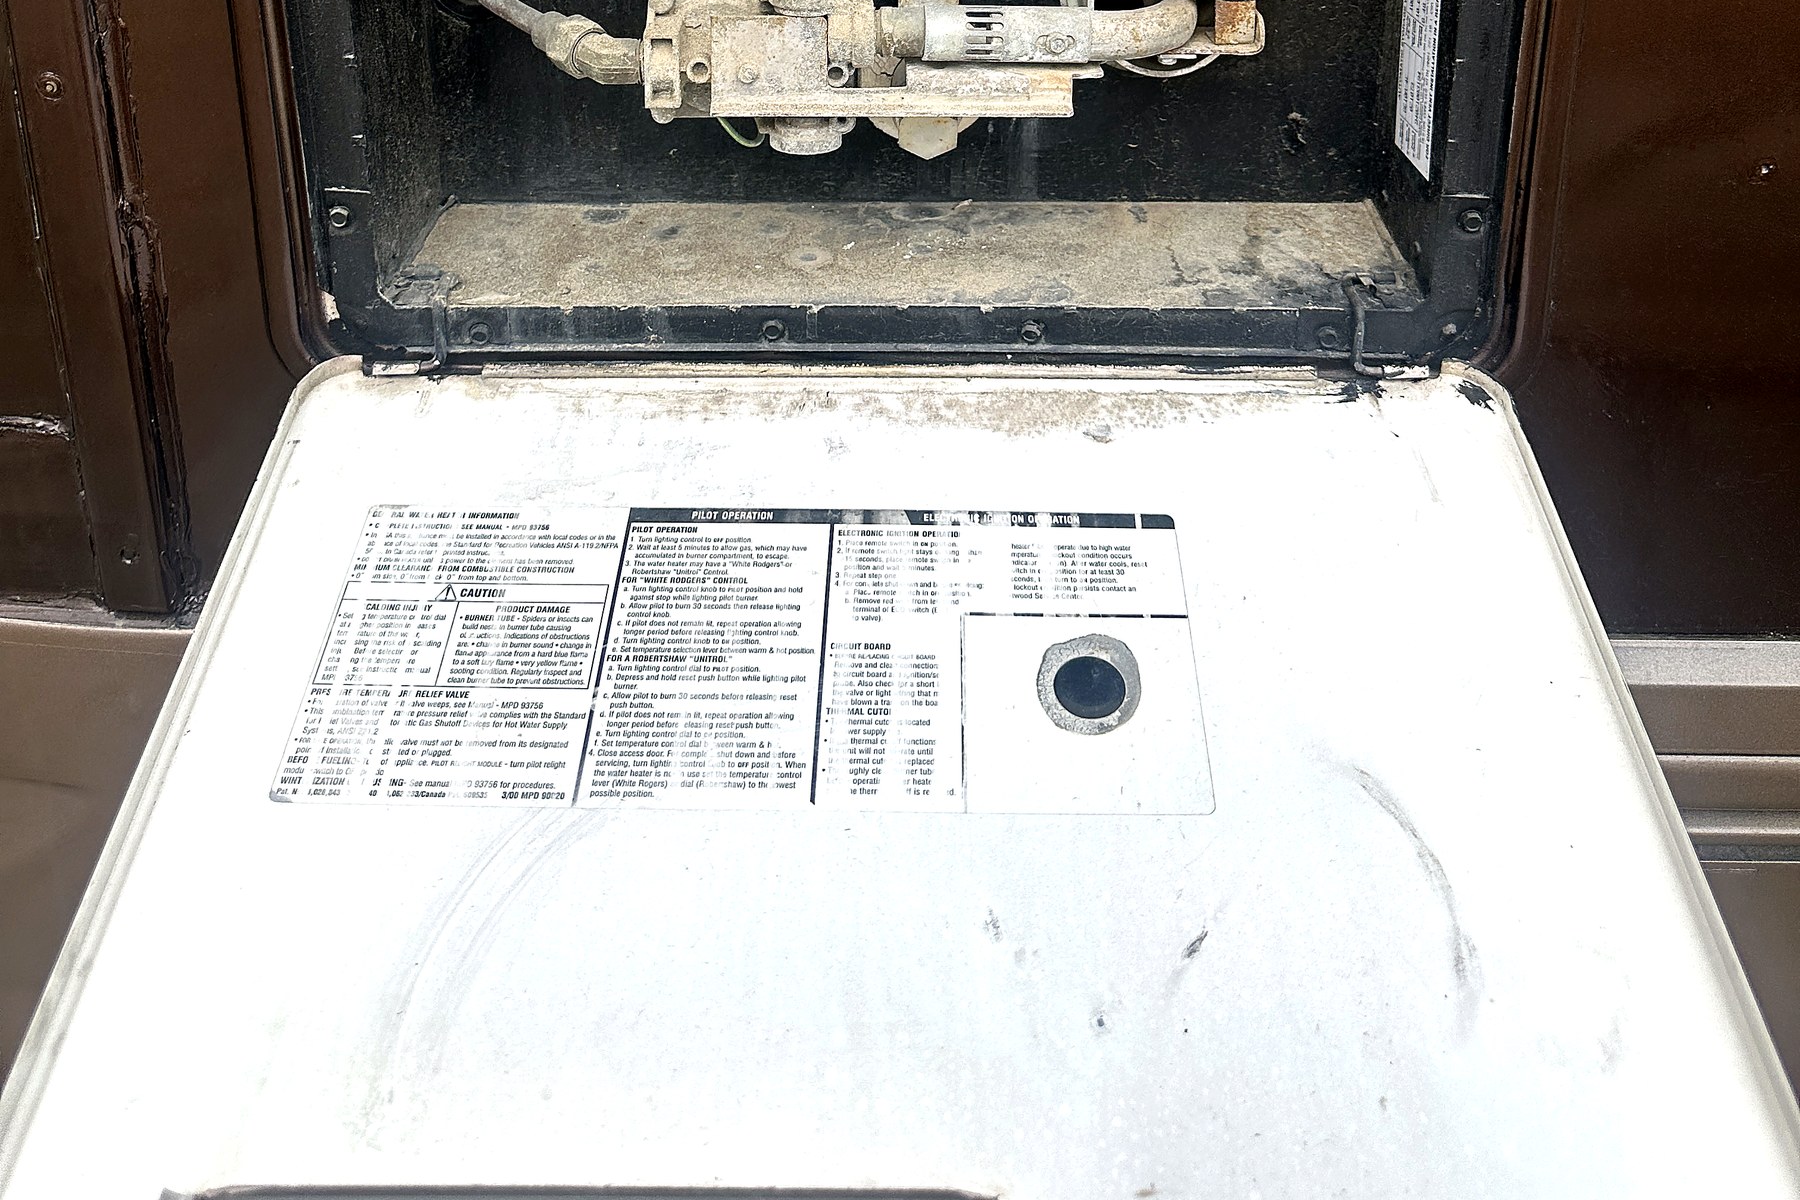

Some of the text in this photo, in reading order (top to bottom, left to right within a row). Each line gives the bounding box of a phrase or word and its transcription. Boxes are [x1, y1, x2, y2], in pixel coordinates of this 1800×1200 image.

[1434, 23, 1437, 31] A
[1433, 31, 1437, 41] IN
[692, 512, 774, 521] PILOT OPERATION
[460, 588, 506, 597] CAUTION
[692, 594, 717, 602] lighting
[496, 605, 534, 613] PRODUCT
[522, 615, 546, 623] Spiders
[510, 668, 542, 676] Regularly
[501, 701, 519, 709] MPD
[609, 701, 628, 709] push
[542, 721, 567, 730] Supply
[474, 780, 498, 788] 93756
[501, 791, 519, 799] 3/00
[622, 790, 655, 798] position.
